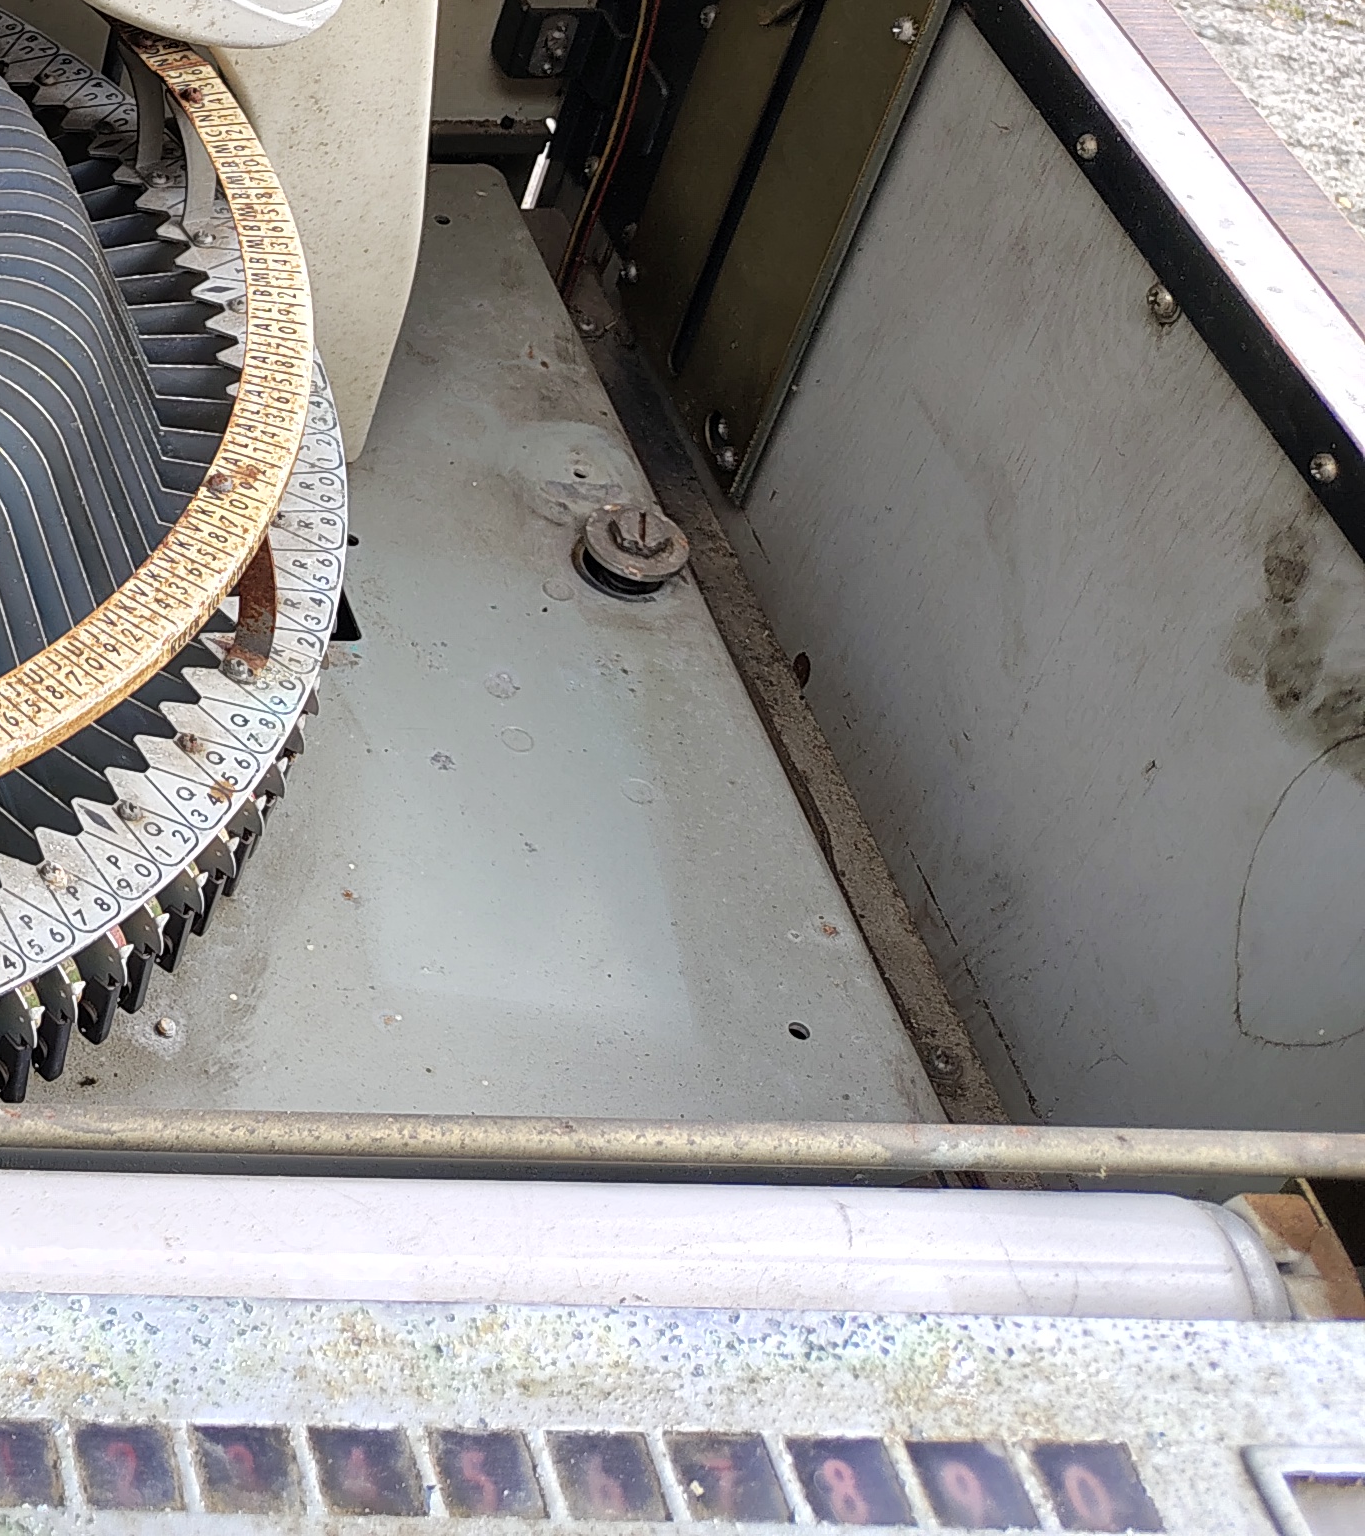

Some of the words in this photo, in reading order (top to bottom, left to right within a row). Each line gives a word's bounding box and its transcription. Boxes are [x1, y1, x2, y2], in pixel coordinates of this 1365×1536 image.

[105, 1441, 142, 1506] 2
[461, 1449, 499, 1513] 5
[821, 1460, 866, 1523] 8
[1065, 1466, 1116, 1530] 0
